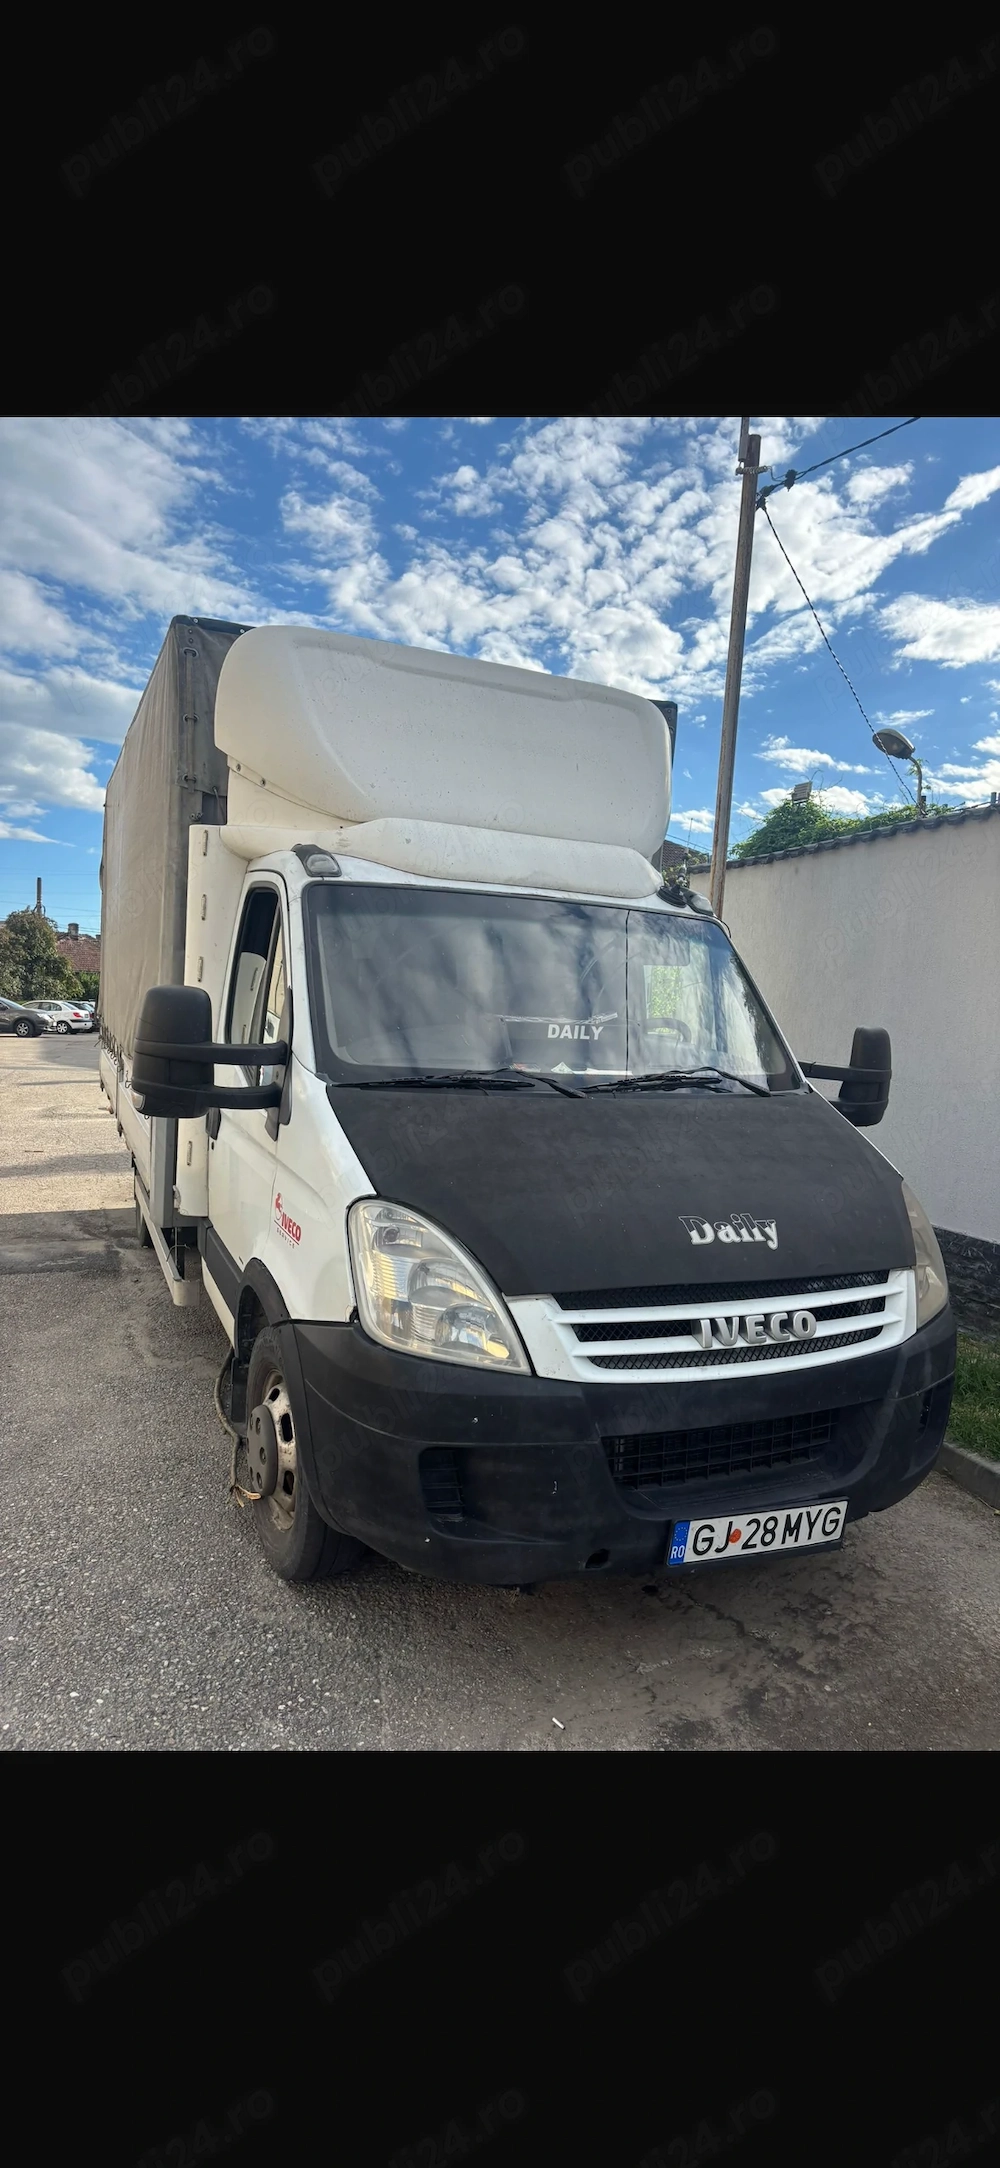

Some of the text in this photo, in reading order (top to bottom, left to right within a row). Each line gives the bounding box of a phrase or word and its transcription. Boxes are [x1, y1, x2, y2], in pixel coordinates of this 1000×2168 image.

[547, 1023, 604, 1041] DAILY
[281, 1211, 302, 1242] IVECO
[678, 1213, 778, 1250] Daily
[692, 1310, 817, 1349] IVECO
[670, 1545, 686, 1560] RO
